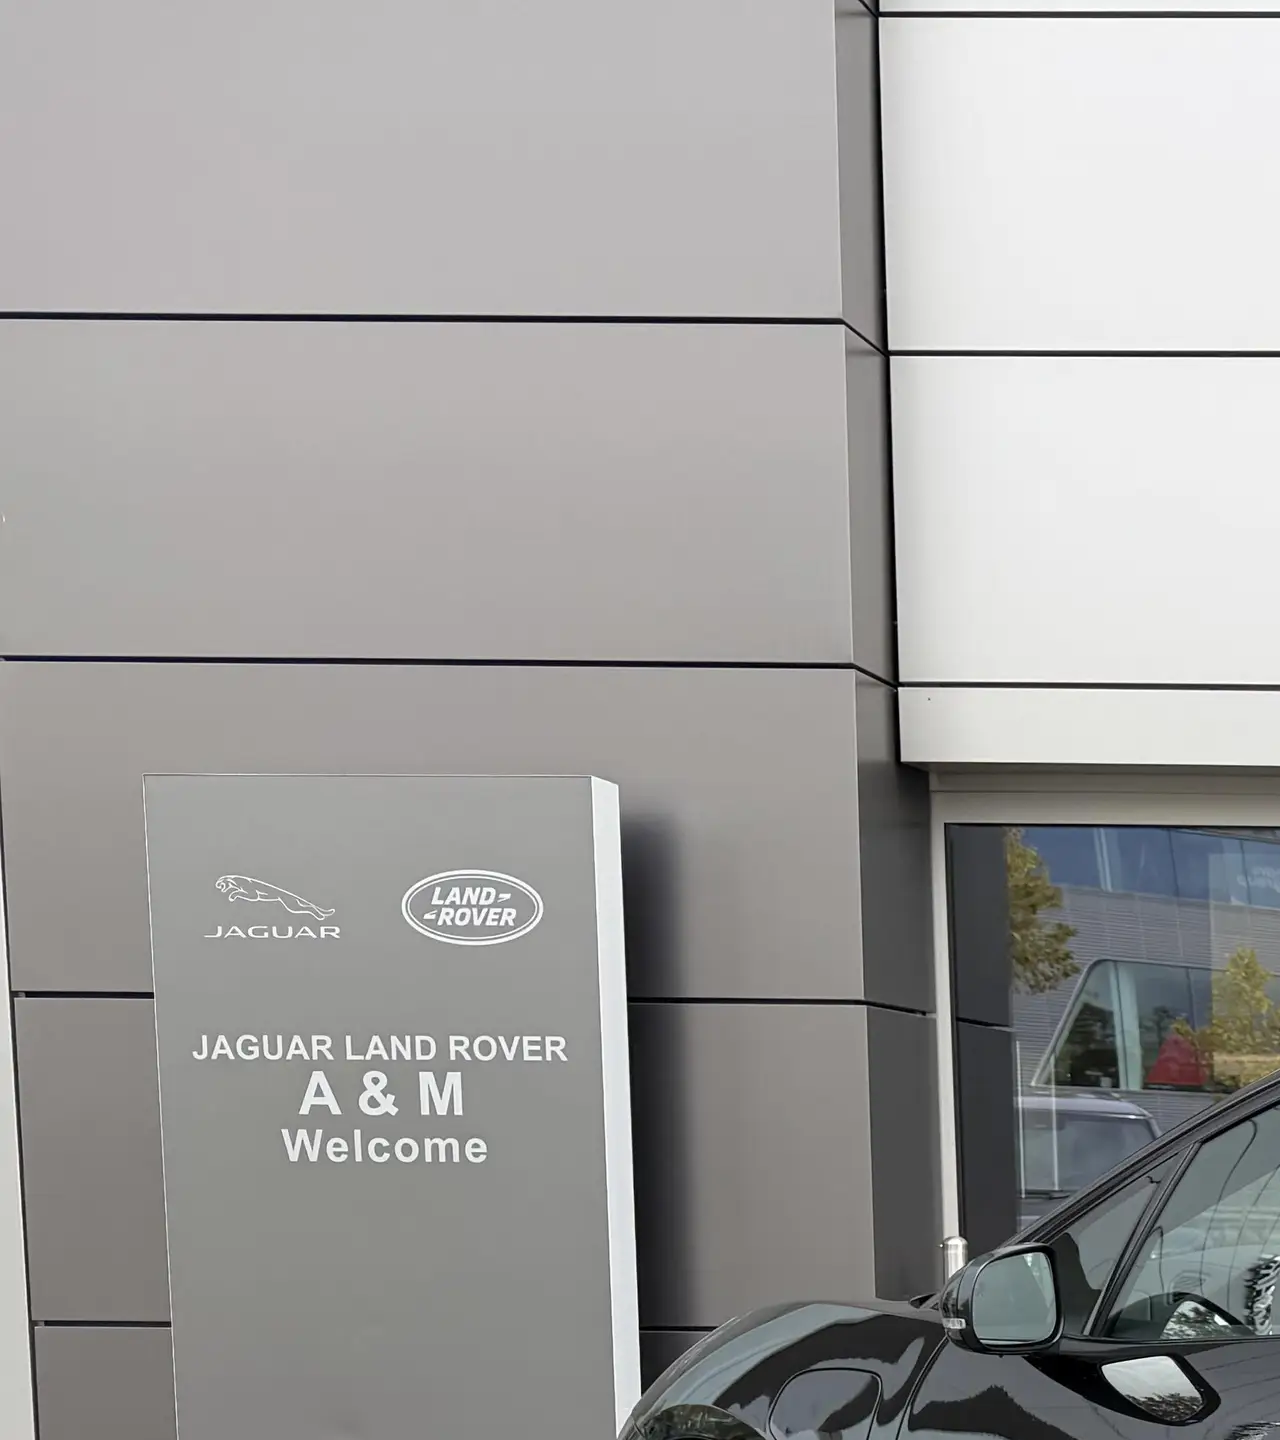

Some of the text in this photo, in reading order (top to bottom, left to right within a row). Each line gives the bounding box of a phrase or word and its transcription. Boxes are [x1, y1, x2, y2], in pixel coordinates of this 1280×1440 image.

[430, 886, 497, 906] LAND
[436, 907, 517, 927] ROVER
[203, 925, 341, 939] JAGUAR
[192, 1034, 569, 1062] JAGUAR LAND ROVER
[298, 1070, 464, 1116] A & M
[281, 1128, 488, 1163] Welcome
